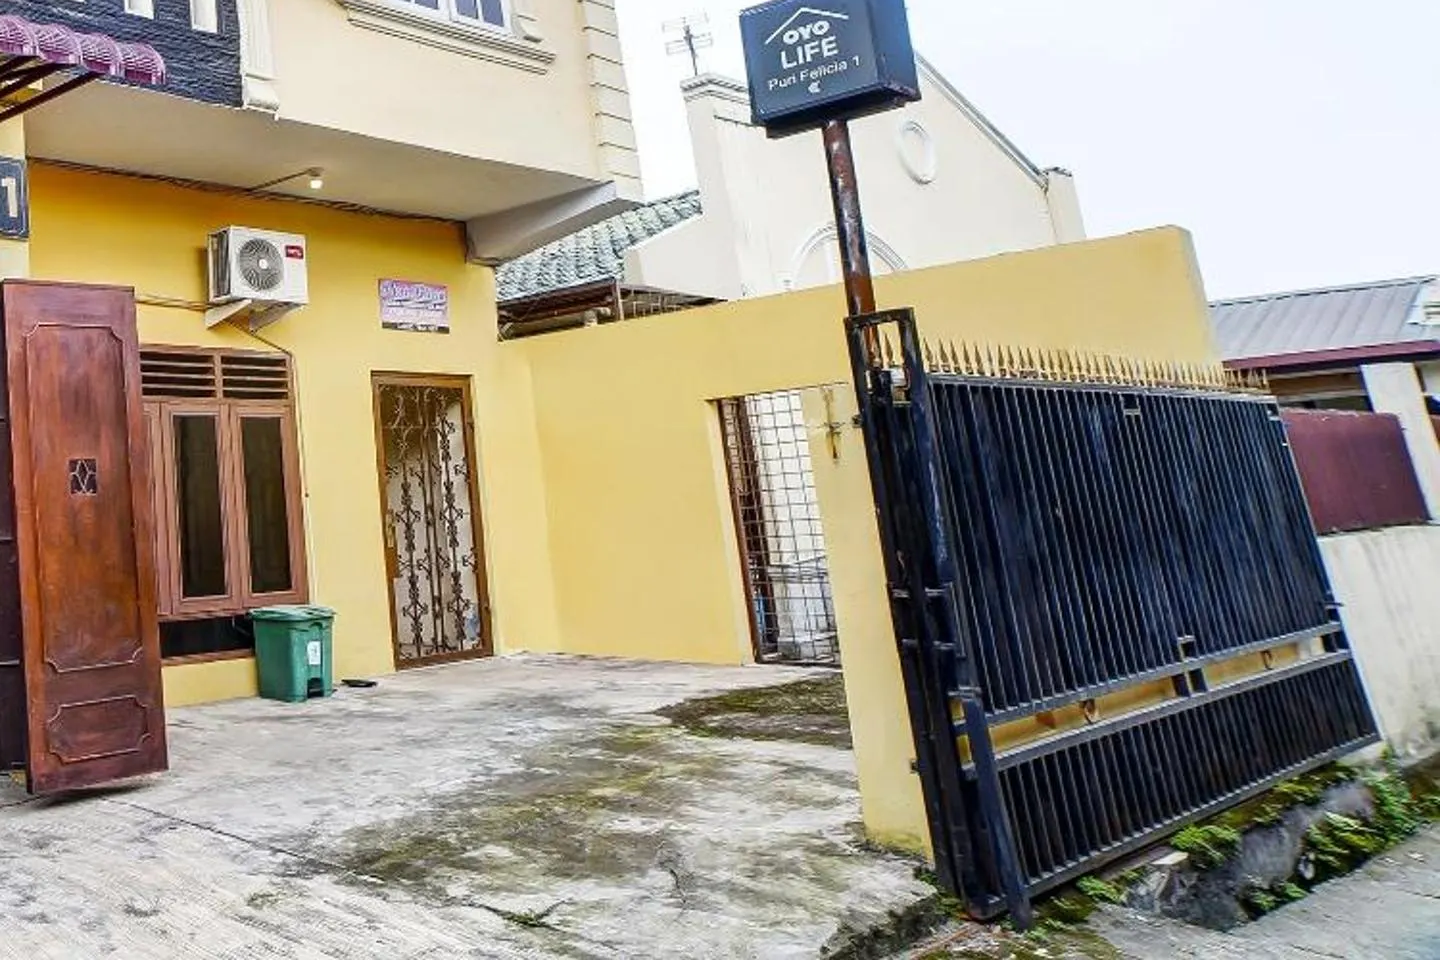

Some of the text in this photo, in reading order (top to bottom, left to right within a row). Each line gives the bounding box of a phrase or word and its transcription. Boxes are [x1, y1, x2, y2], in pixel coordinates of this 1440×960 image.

[782, 20, 830, 45] OYO
[780, 36, 840, 70] LIFE
[799, 61, 848, 83] Felicia
[852, 55, 860, 67] 1
[1, 176, 18, 218] 1
